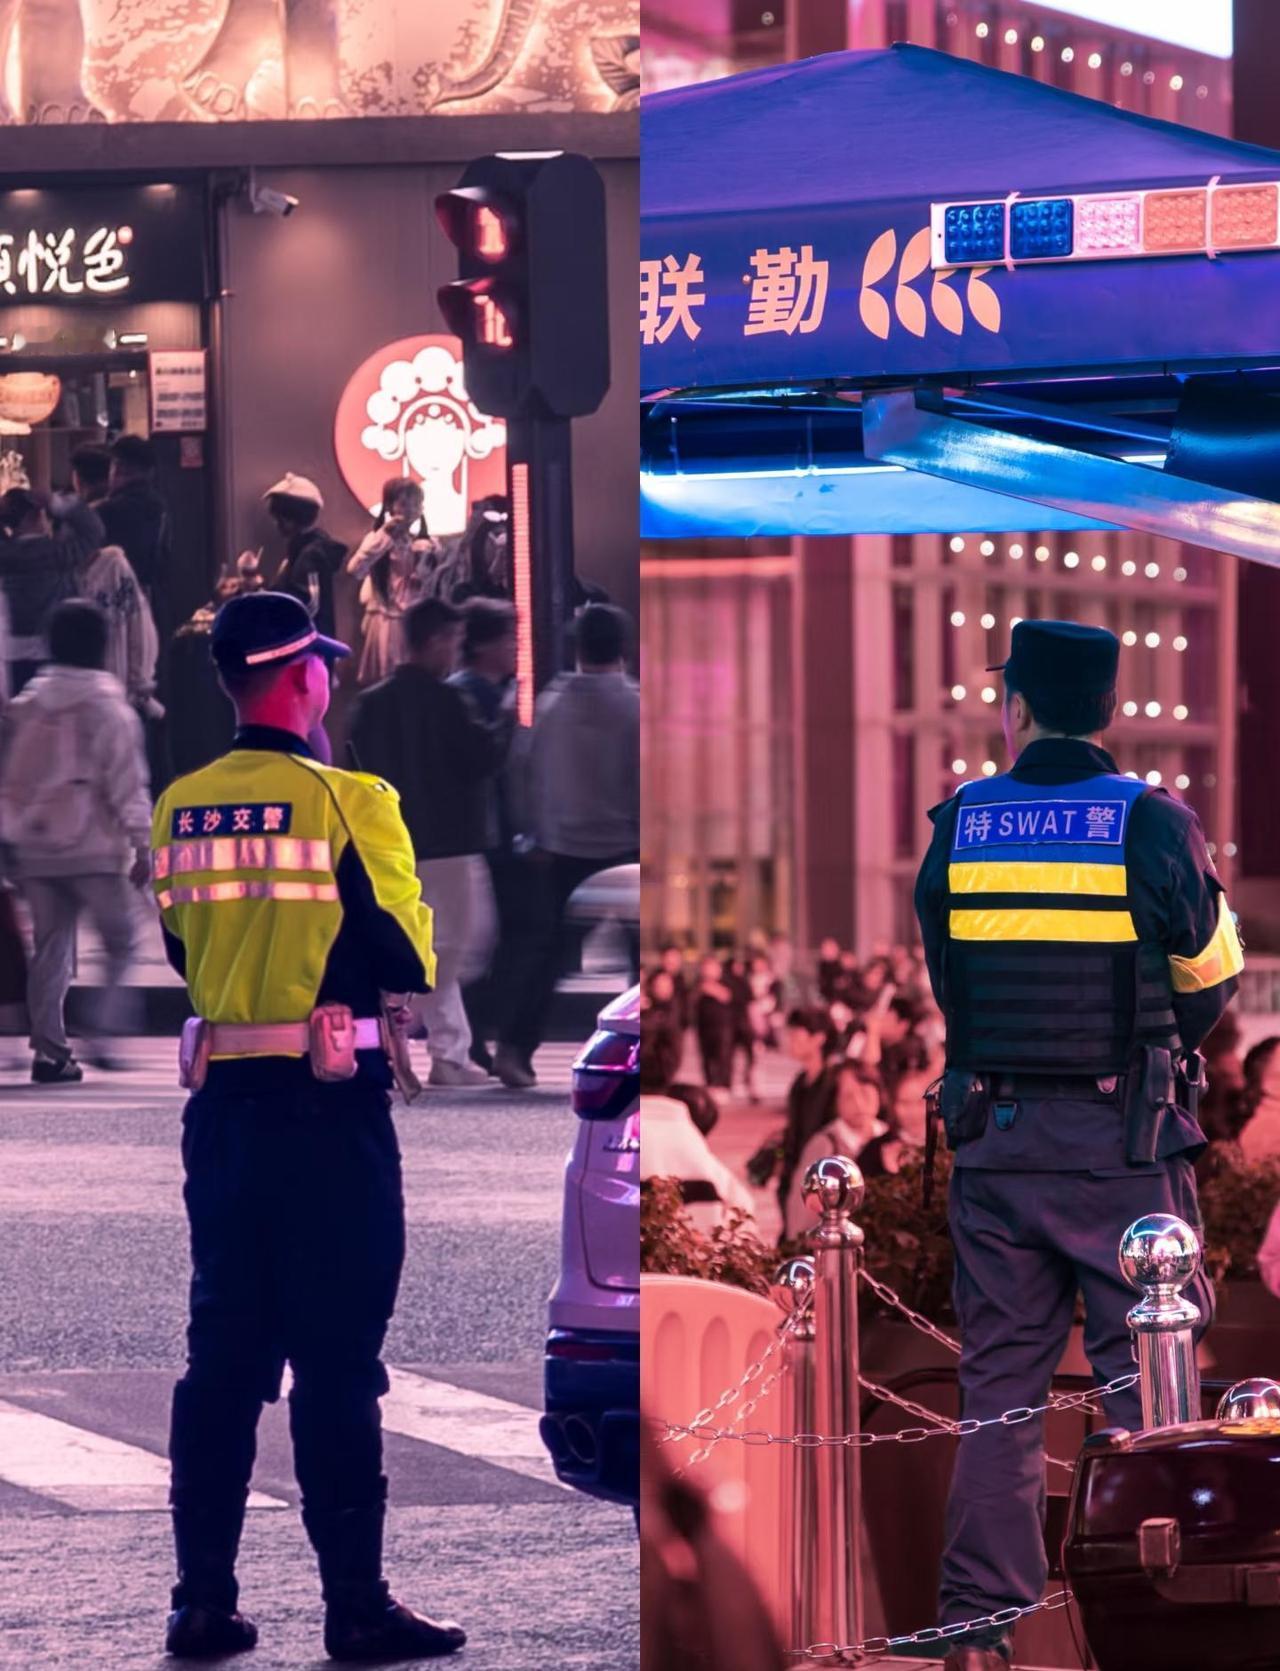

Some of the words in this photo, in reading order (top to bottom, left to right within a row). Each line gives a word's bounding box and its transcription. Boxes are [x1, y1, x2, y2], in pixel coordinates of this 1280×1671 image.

[178, 806, 284, 834] 长沙交警
[964, 810, 993, 843] 特
[998, 810, 1077, 837] SWAT
[1085, 806, 1117, 839] 警
